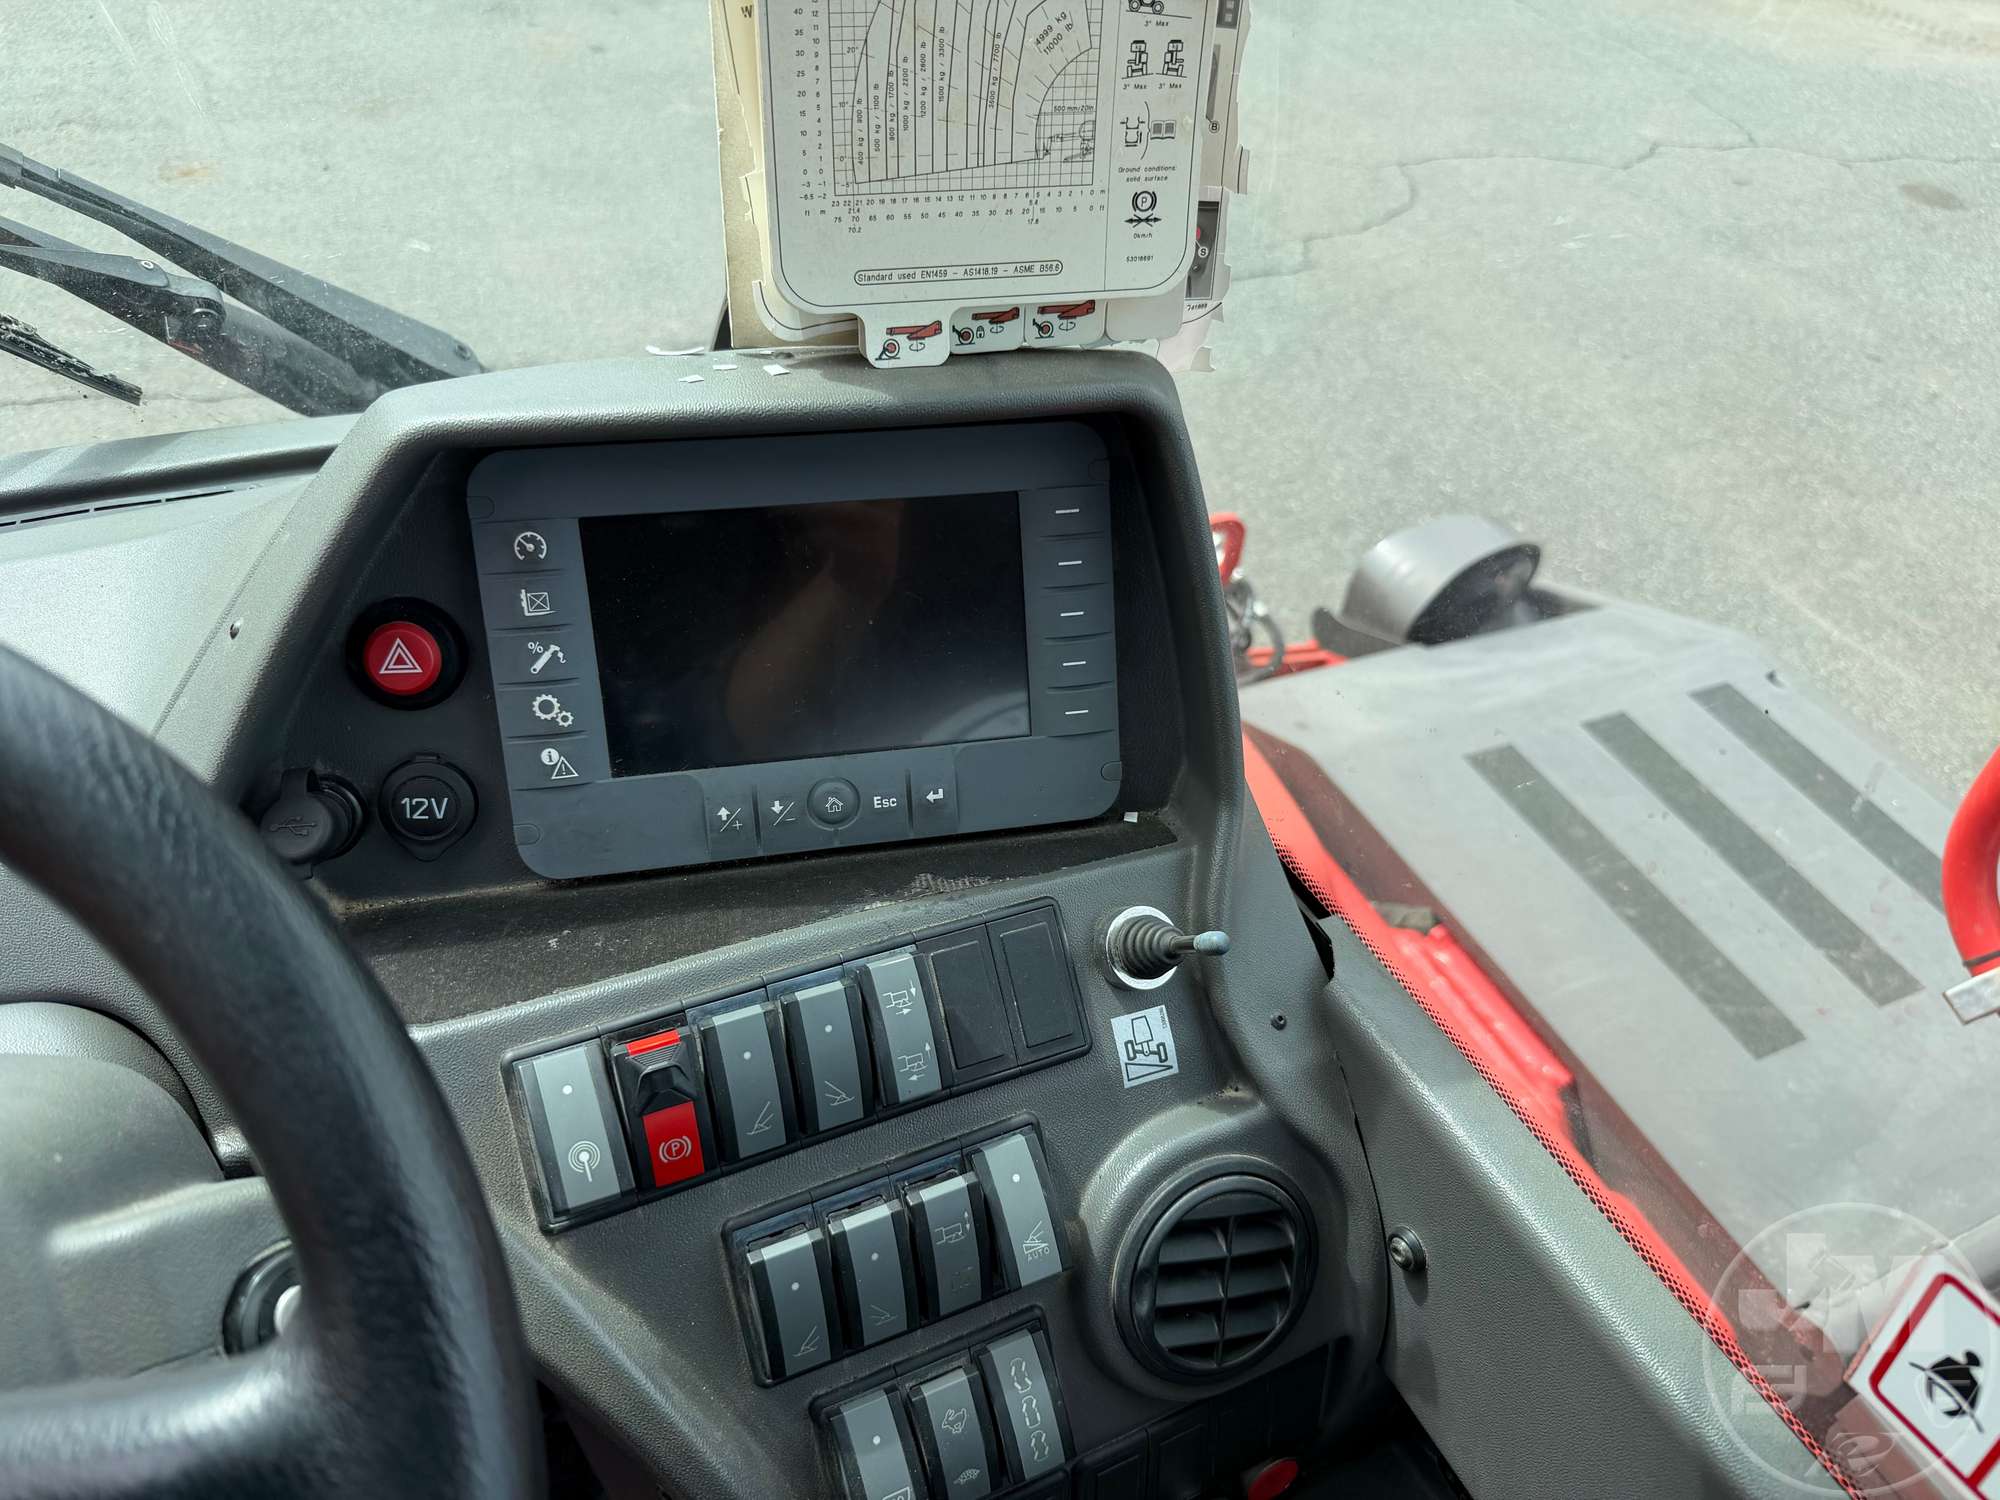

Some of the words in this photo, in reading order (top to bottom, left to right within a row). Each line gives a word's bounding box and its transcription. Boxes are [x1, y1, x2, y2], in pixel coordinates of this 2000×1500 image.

[1035, 24, 1054, 46] 4999
[1054, 11, 1067, 24] kg
[1043, 33, 1063, 55] 11000
[1064, 22, 1073, 32] lb
[939, 71, 946, 81] kg
[992, 76, 999, 86] kg
[920, 86, 927, 96] kg
[903, 100, 910, 110] kg
[889, 112, 896, 122] kg
[875, 124, 881, 134] kg
[858, 137, 864, 147] kg
[1005, 208, 1013, 216] 25
[1022, 207, 1030, 215] 20
[847, 226, 862, 234] 70.2
[857, 272, 893, 283] Standard
[897, 271, 917, 280] used
[920, 269, 948, 279] EN1459
[963, 266, 999, 277] AS1418.19
[1013, 264, 1035, 274] ASME
[873, 796, 898, 809] Esc
[401, 797, 449, 820] 12V
